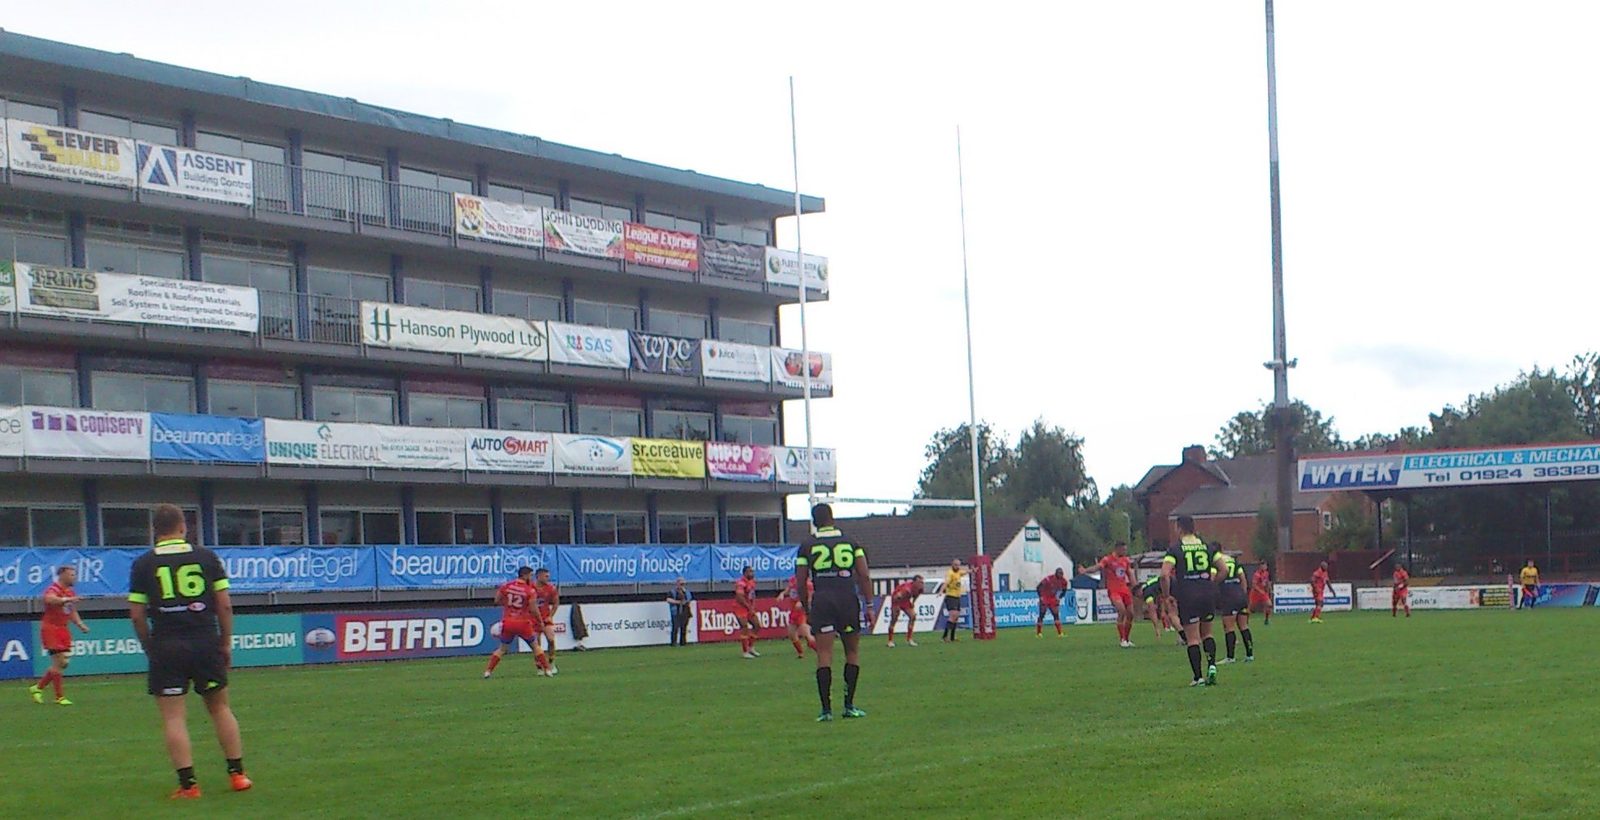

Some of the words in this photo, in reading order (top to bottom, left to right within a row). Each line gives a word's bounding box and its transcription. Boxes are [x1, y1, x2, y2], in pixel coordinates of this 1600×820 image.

[64, 132, 119, 156] EVER
[183, 152, 246, 176] ASSENT
[183, 170, 219, 187] Building
[625, 223, 659, 247] League
[660, 230, 698, 252] Express
[31, 266, 97, 290] TRIMS
[139, 278, 177, 289] Specialist
[179, 282, 216, 294] Suppliers
[127, 288, 163, 299] Roofline
[164, 291, 171, 299] &
[172, 292, 204, 304] Roofing
[204, 295, 242, 307] Materials
[111, 297, 128, 307] Soil
[128, 299, 160, 310] System
[170, 303, 223, 315] Underground
[224, 308, 258, 321] Drainage
[140, 311, 190, 325] Contracting
[190, 317, 237, 327] Installation
[400, 318, 456, 340] Hanson
[460, 323, 515, 346] Plywood
[519, 330, 543, 348] Ltd
[584, 336, 613, 353] SAS
[153, 423, 263, 451] beaumontlega
[268, 440, 318, 461] UNIQUE
[320, 443, 382, 462] ELECTRICAL
[631, 443, 704, 460] sr.creative
[707, 443, 754, 464] HIPPO
[1407, 454, 1506, 471] ELECTRICAL
[1511, 453, 1524, 464] &
[1311, 462, 1395, 486] WYTEK
[1424, 472, 1451, 484] Tel
[1459, 469, 1523, 482] 01924
[221, 548, 358, 583] umontlegal
[580, 554, 637, 577] moving
[641, 553, 692, 574] house?
[811, 543, 854, 570] 26
[1184, 551, 1209, 572] 13
[28, 564, 43, 583] a
[155, 563, 206, 600] 16
[506, 592, 524, 608] 12
[918, 604, 935, 616] £30
[1411, 595, 1437, 607] john's
[344, 616, 484, 653] BETFRED
[591, 620, 613, 631] home
[614, 618, 624, 630] of
[625, 618, 646, 632] Super
[648, 617, 673, 632] Leagu
